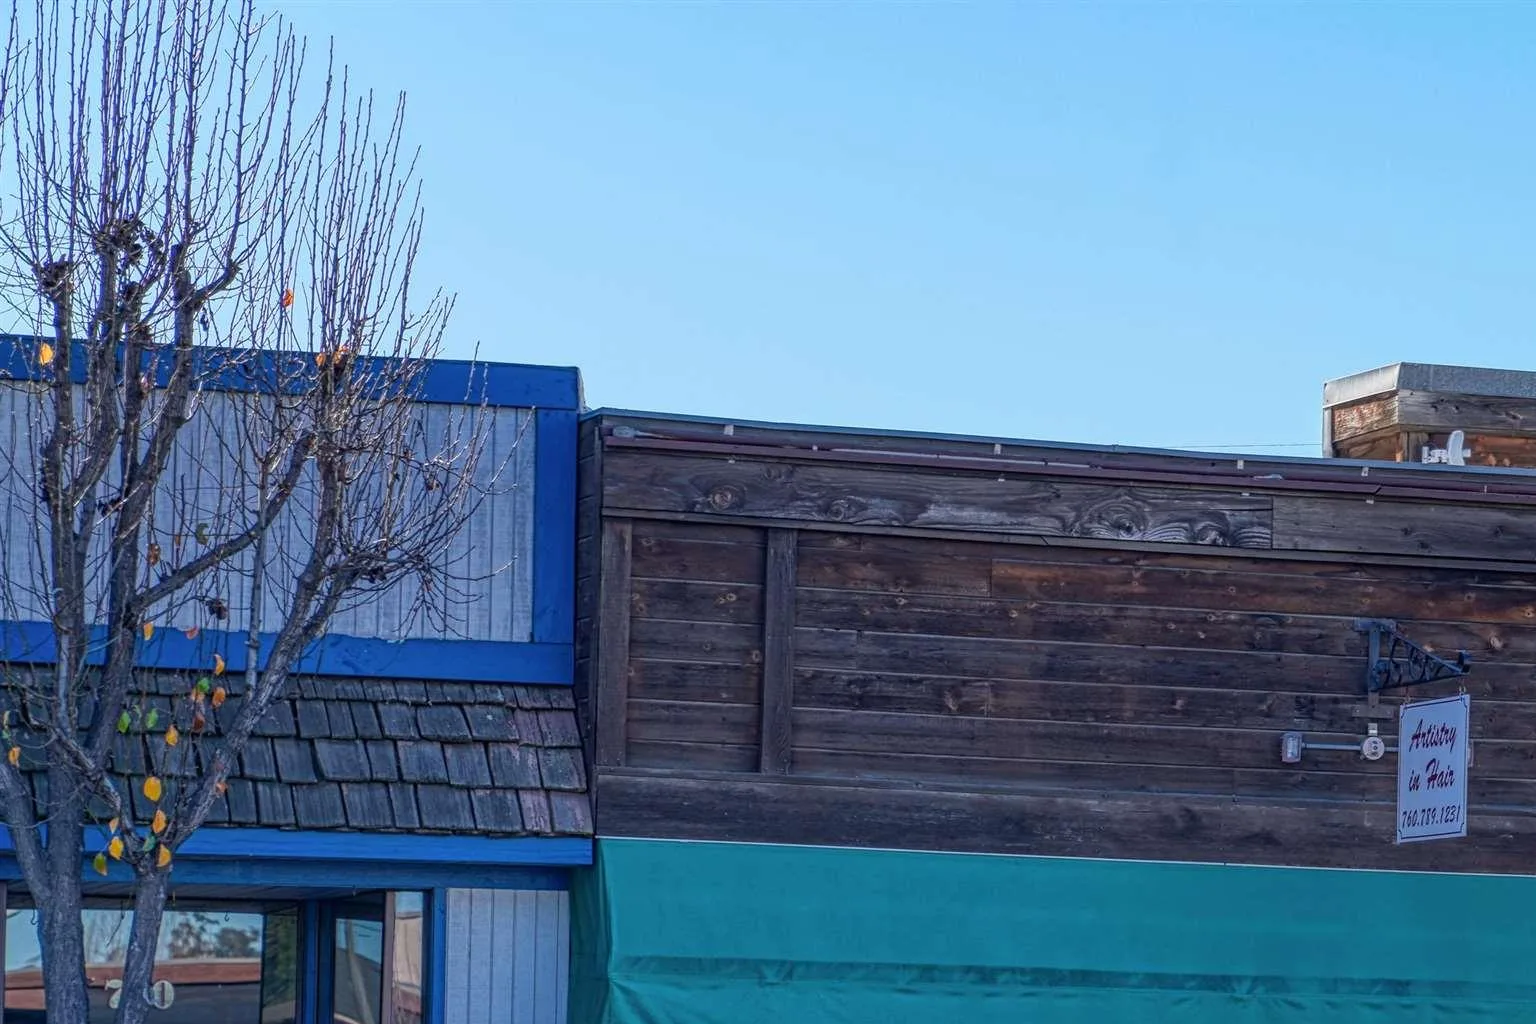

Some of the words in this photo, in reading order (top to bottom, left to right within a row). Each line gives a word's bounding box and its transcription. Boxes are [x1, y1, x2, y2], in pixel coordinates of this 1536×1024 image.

[1408, 718, 1456, 752] Artistry
[1408, 769, 1420, 792] in
[1426, 758, 1455, 790] Hair
[1402, 803, 1461, 829] 760.789.1231
[104, 979, 175, 1009] 70
